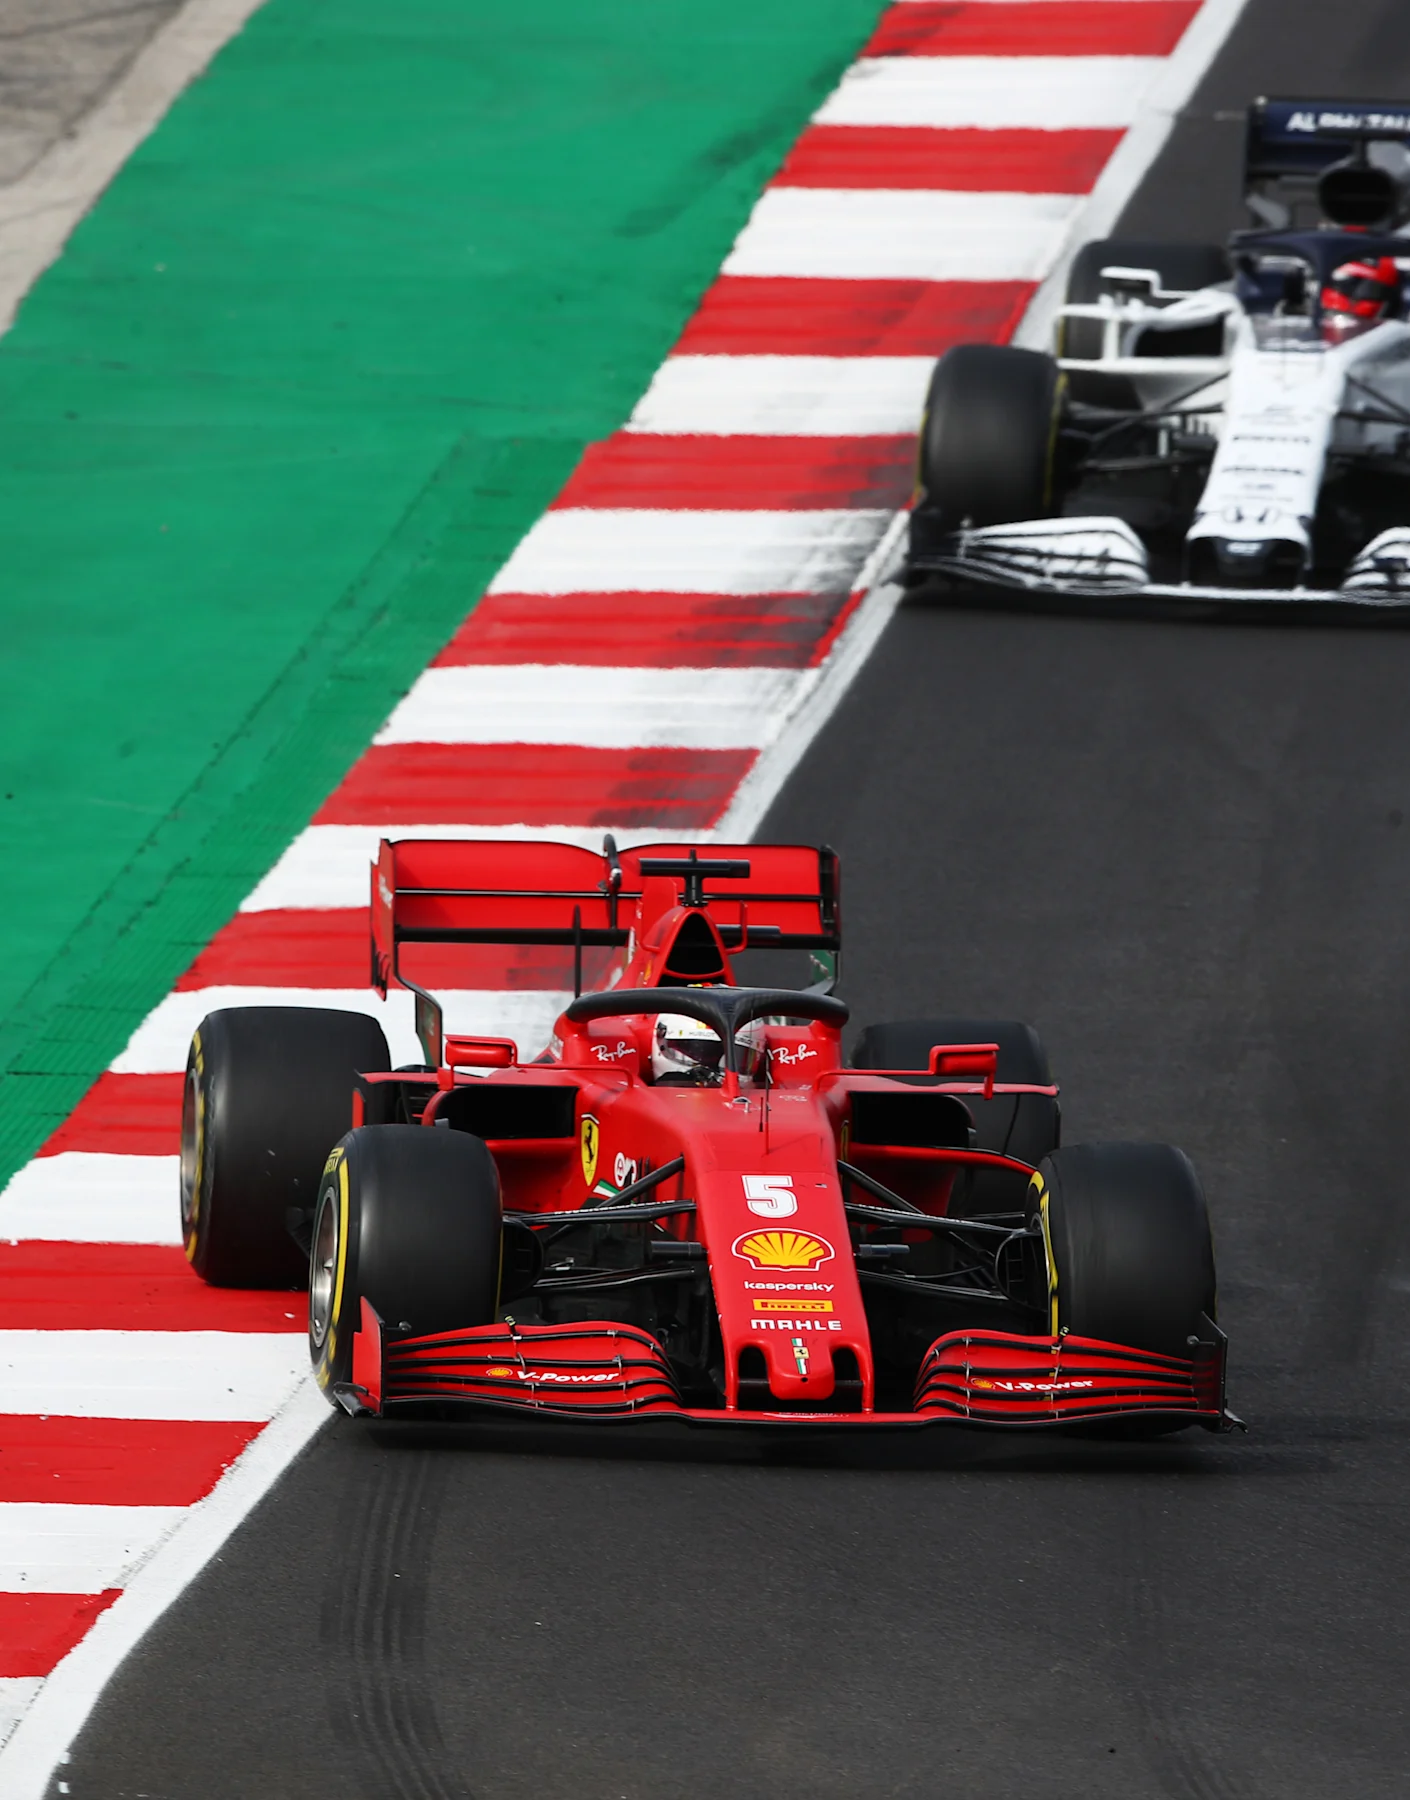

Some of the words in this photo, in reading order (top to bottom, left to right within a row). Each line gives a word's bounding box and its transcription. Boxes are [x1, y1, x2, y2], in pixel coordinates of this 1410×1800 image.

[591, 1041, 637, 1062] Ray-Ban
[773, 1044, 818, 1065] Ray-Ban
[741, 1174, 799, 1219] 5
[744, 1280, 835, 1293] kaspersky
[760, 1301, 825, 1310] PIRELLI
[750, 1319, 843, 1331] MAHLE
[516, 1370, 619, 1383] V-Power
[994, 1378, 1094, 1392] V-Power
